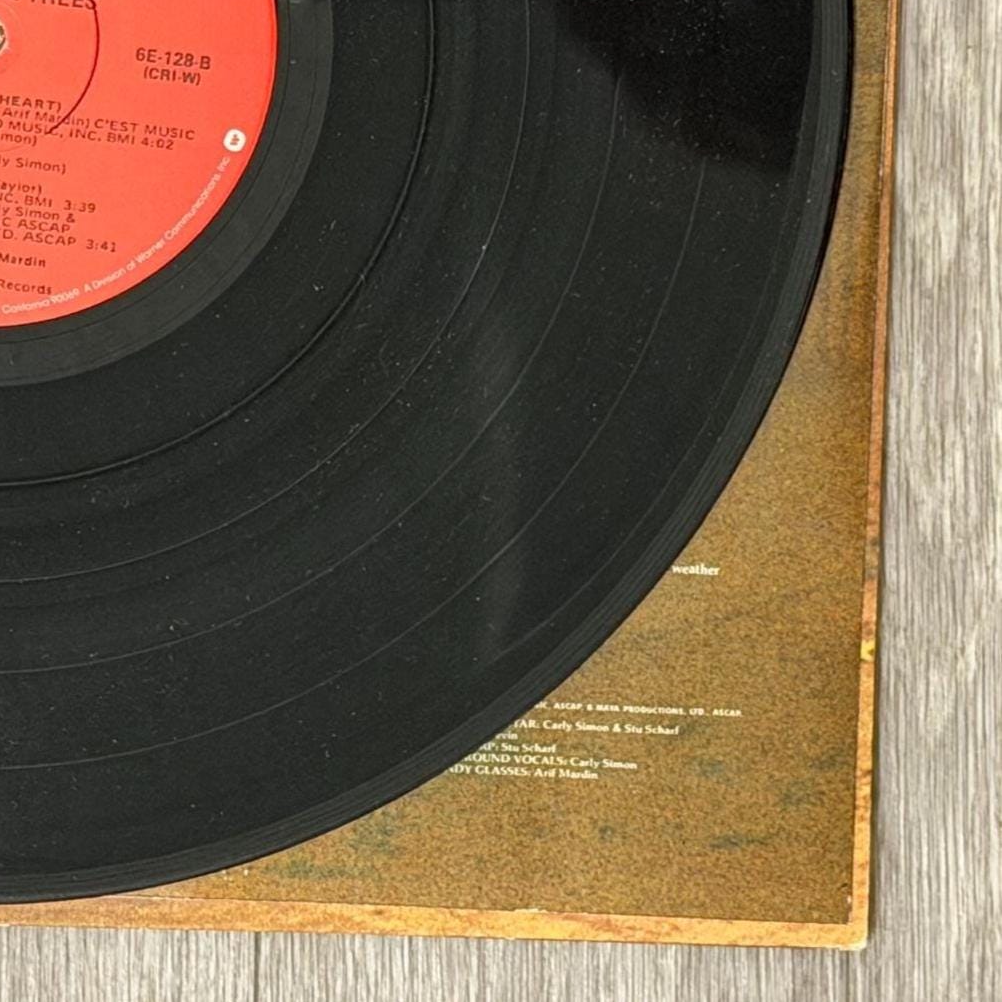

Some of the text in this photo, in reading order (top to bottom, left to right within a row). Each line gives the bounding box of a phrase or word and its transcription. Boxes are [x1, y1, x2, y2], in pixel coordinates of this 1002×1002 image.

[135, 47, 211, 70] 6E-128-B
[143, 65, 202, 87] (CRI-W)
[0, 94, 62, 113] HEART)
[2, 107, 30, 119] Arif
[94, 118, 139, 133] C'EST
[144, 124, 195, 140] MUSIC
[106, 132, 135, 145] BMI
[141, 137, 174, 150] 4:02
[15, 157, 67, 175] Simon)
[24, 195, 53, 208] BMI
[63, 199, 96, 214] 3:39
[15, 206, 60, 221] Simon
[65, 213, 76, 224] &
[18, 219, 71, 234] ASCAP
[22, 231, 77, 246] ASCAP
[86, 238, 116, 253] 3:41
[671, 563, 720, 576] weather
[542, 720, 679, 736] Carly Simon & Stu Scharf
[501, 743, 520, 753] Stu
[522, 744, 556, 753] Scharf
[514, 754, 637, 770] VOCALS: Carly Simon
[534, 767, 599, 780] Arif Mardin
